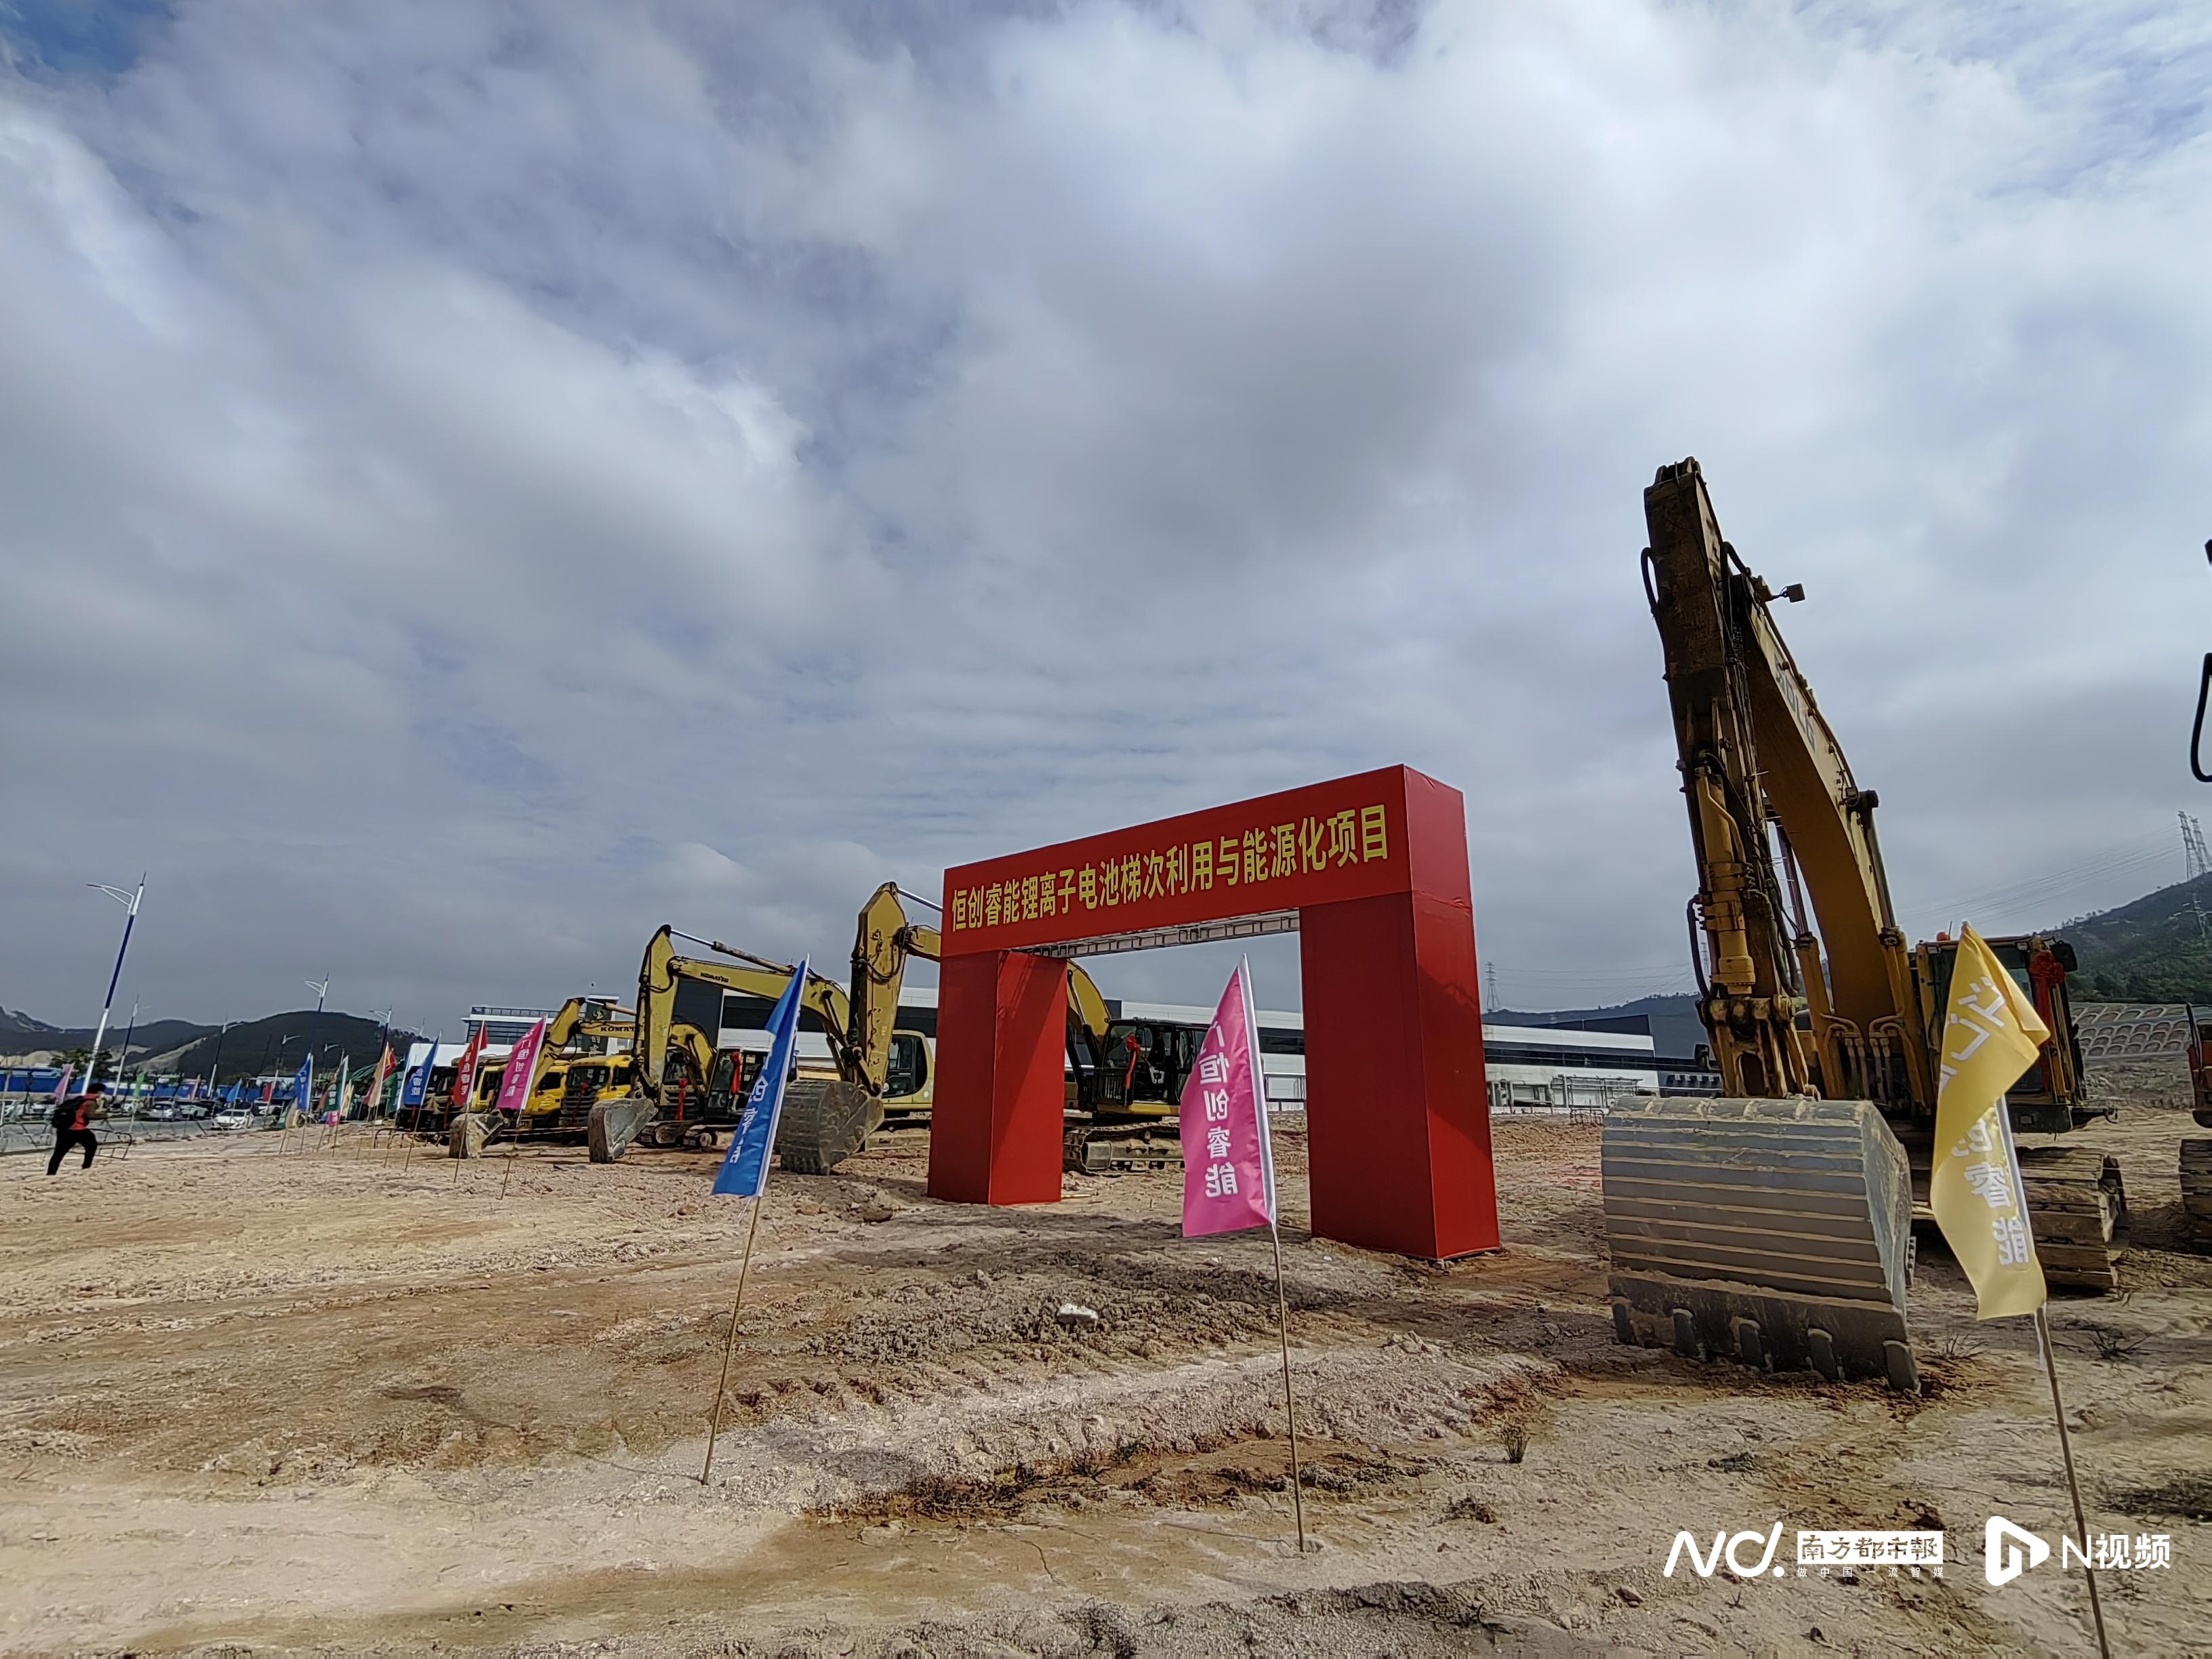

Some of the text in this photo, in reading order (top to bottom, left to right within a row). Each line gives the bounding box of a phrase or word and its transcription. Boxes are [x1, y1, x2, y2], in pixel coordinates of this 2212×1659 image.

[951, 804, 1388, 933] 恒创睿能锂离子电池梯次利用与能源化项目
